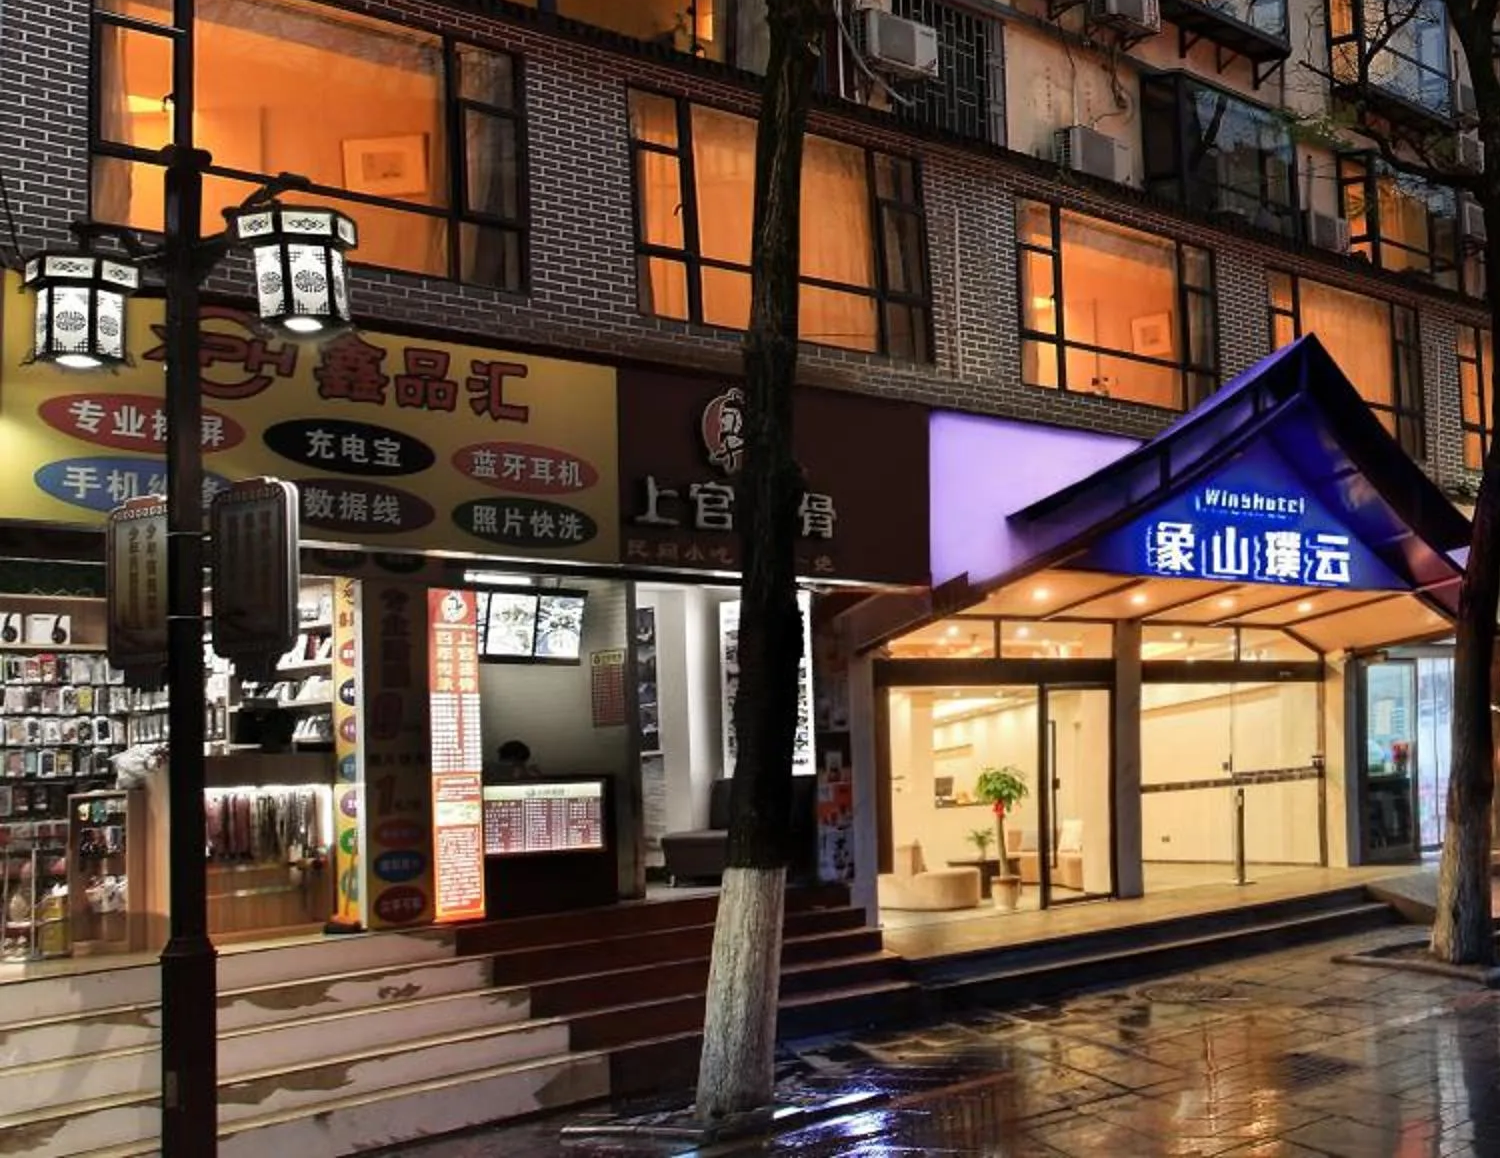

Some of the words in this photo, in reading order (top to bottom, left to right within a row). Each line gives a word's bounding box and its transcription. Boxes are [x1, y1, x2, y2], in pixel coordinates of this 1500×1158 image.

[314, 333, 529, 423] 鑫品汇
[305, 429, 402, 468] 充电宝
[471, 449, 584, 488] 蓝牙耳机
[303, 486, 402, 525] 数据线
[472, 504, 584, 540] 照片快洗
[634, 474, 838, 539] 上官骨
